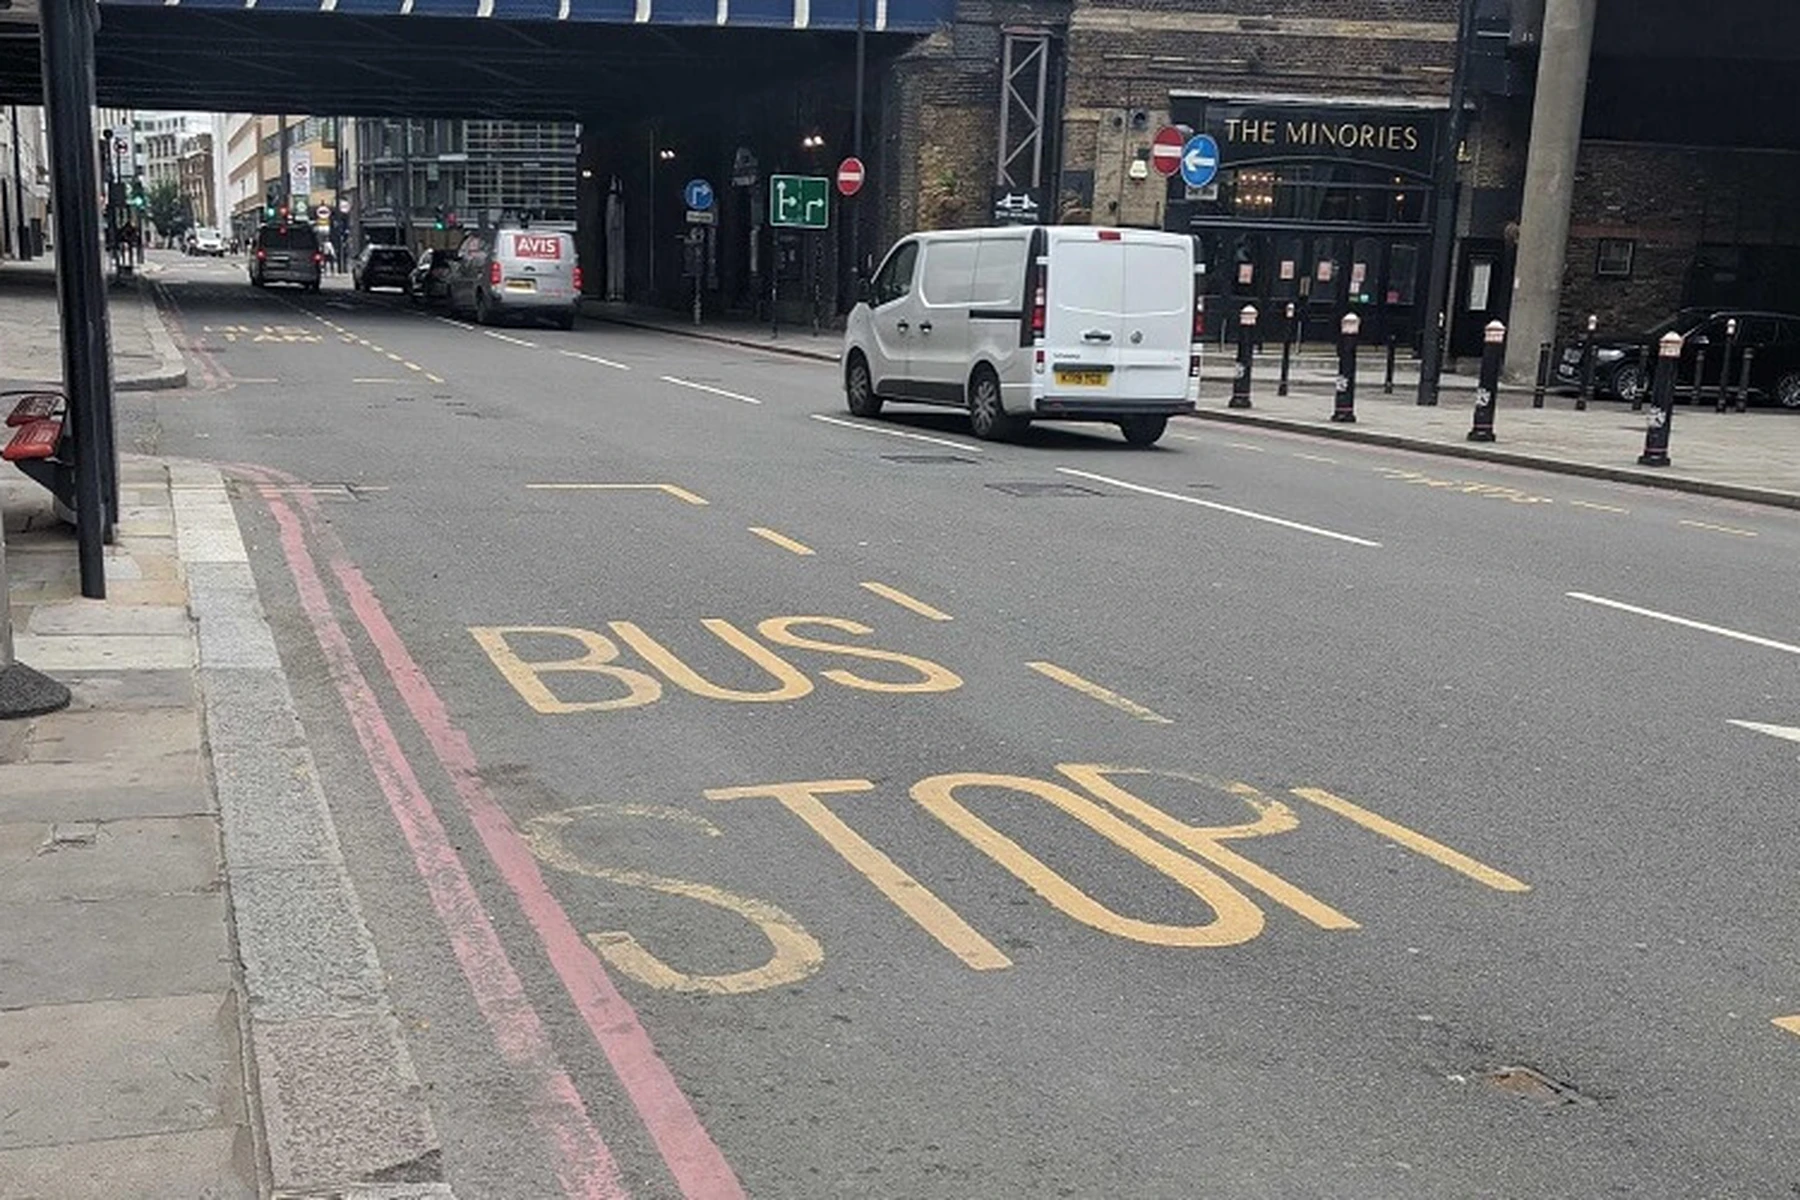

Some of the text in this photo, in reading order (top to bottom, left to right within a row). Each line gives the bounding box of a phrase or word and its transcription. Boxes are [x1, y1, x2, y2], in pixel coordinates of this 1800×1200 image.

[1224, 118, 1418, 151] THE MINORIES
[517, 237, 556, 253] AVIS
[467, 615, 964, 714] BUS
[520, 762, 1361, 996] STOP
